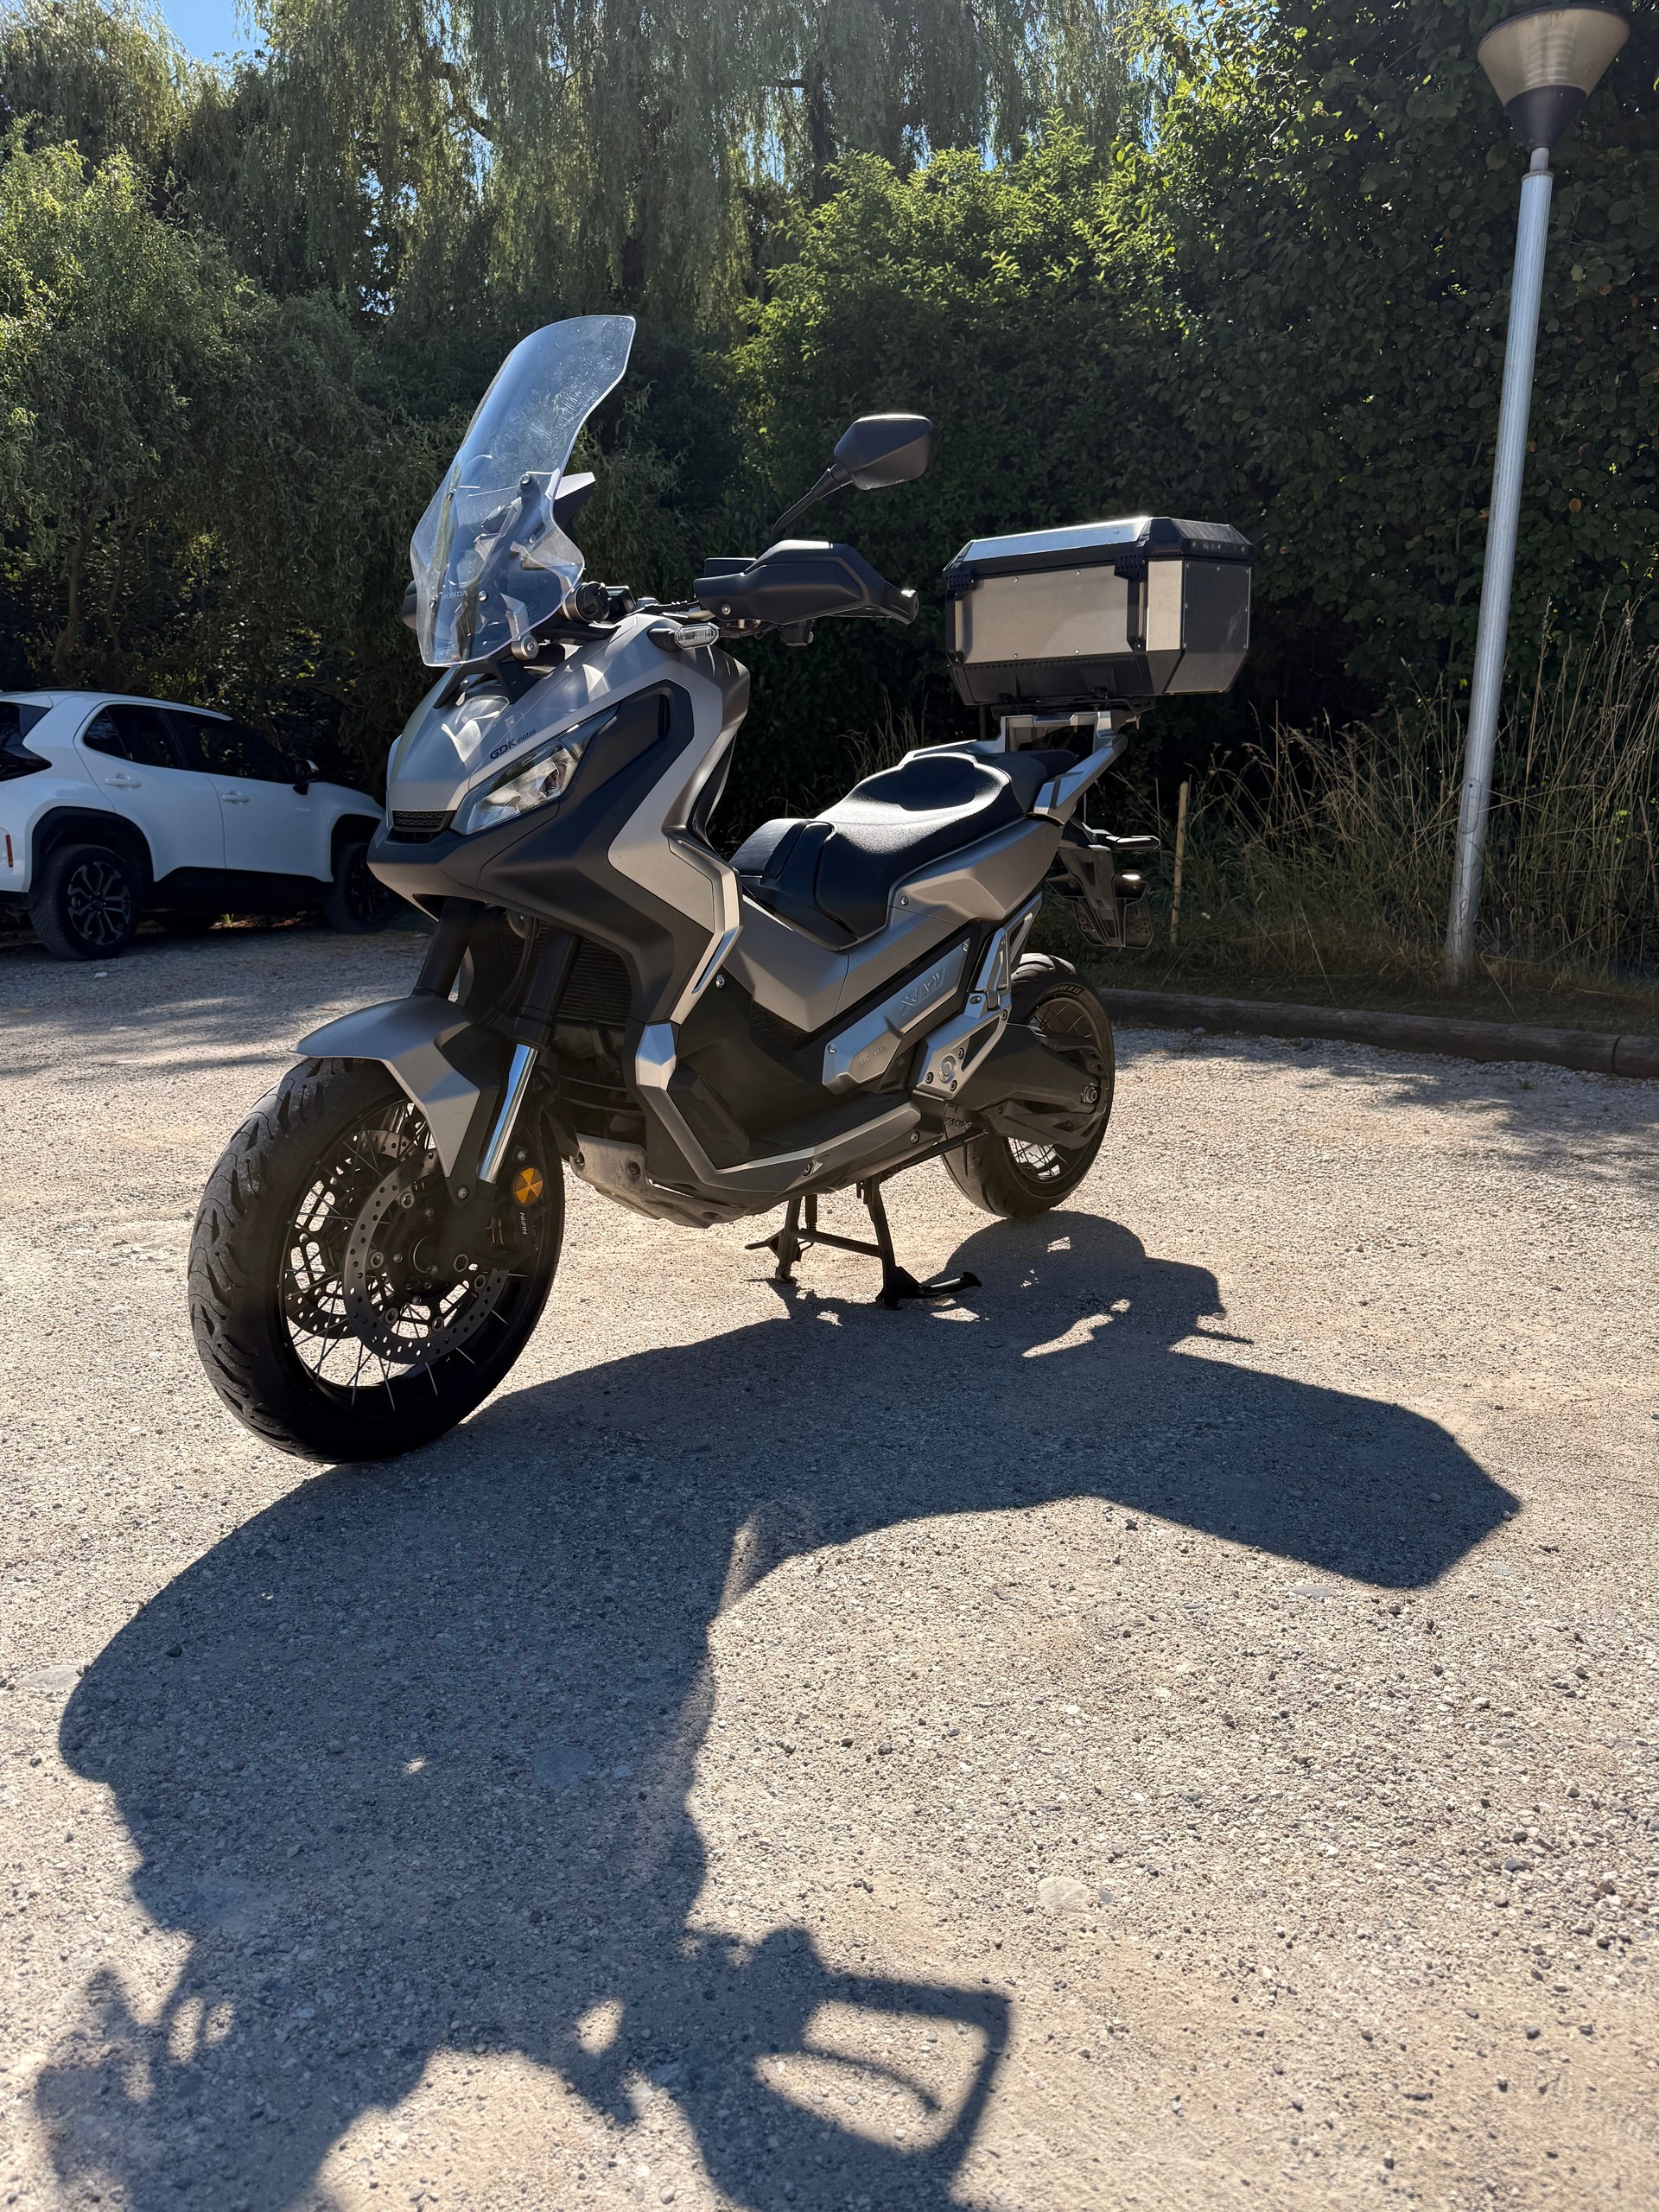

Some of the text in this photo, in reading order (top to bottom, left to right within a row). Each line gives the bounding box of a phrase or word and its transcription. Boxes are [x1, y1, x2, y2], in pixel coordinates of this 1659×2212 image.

[442, 590, 468, 600] HONDA
[490, 728, 537, 760] GDK motos
